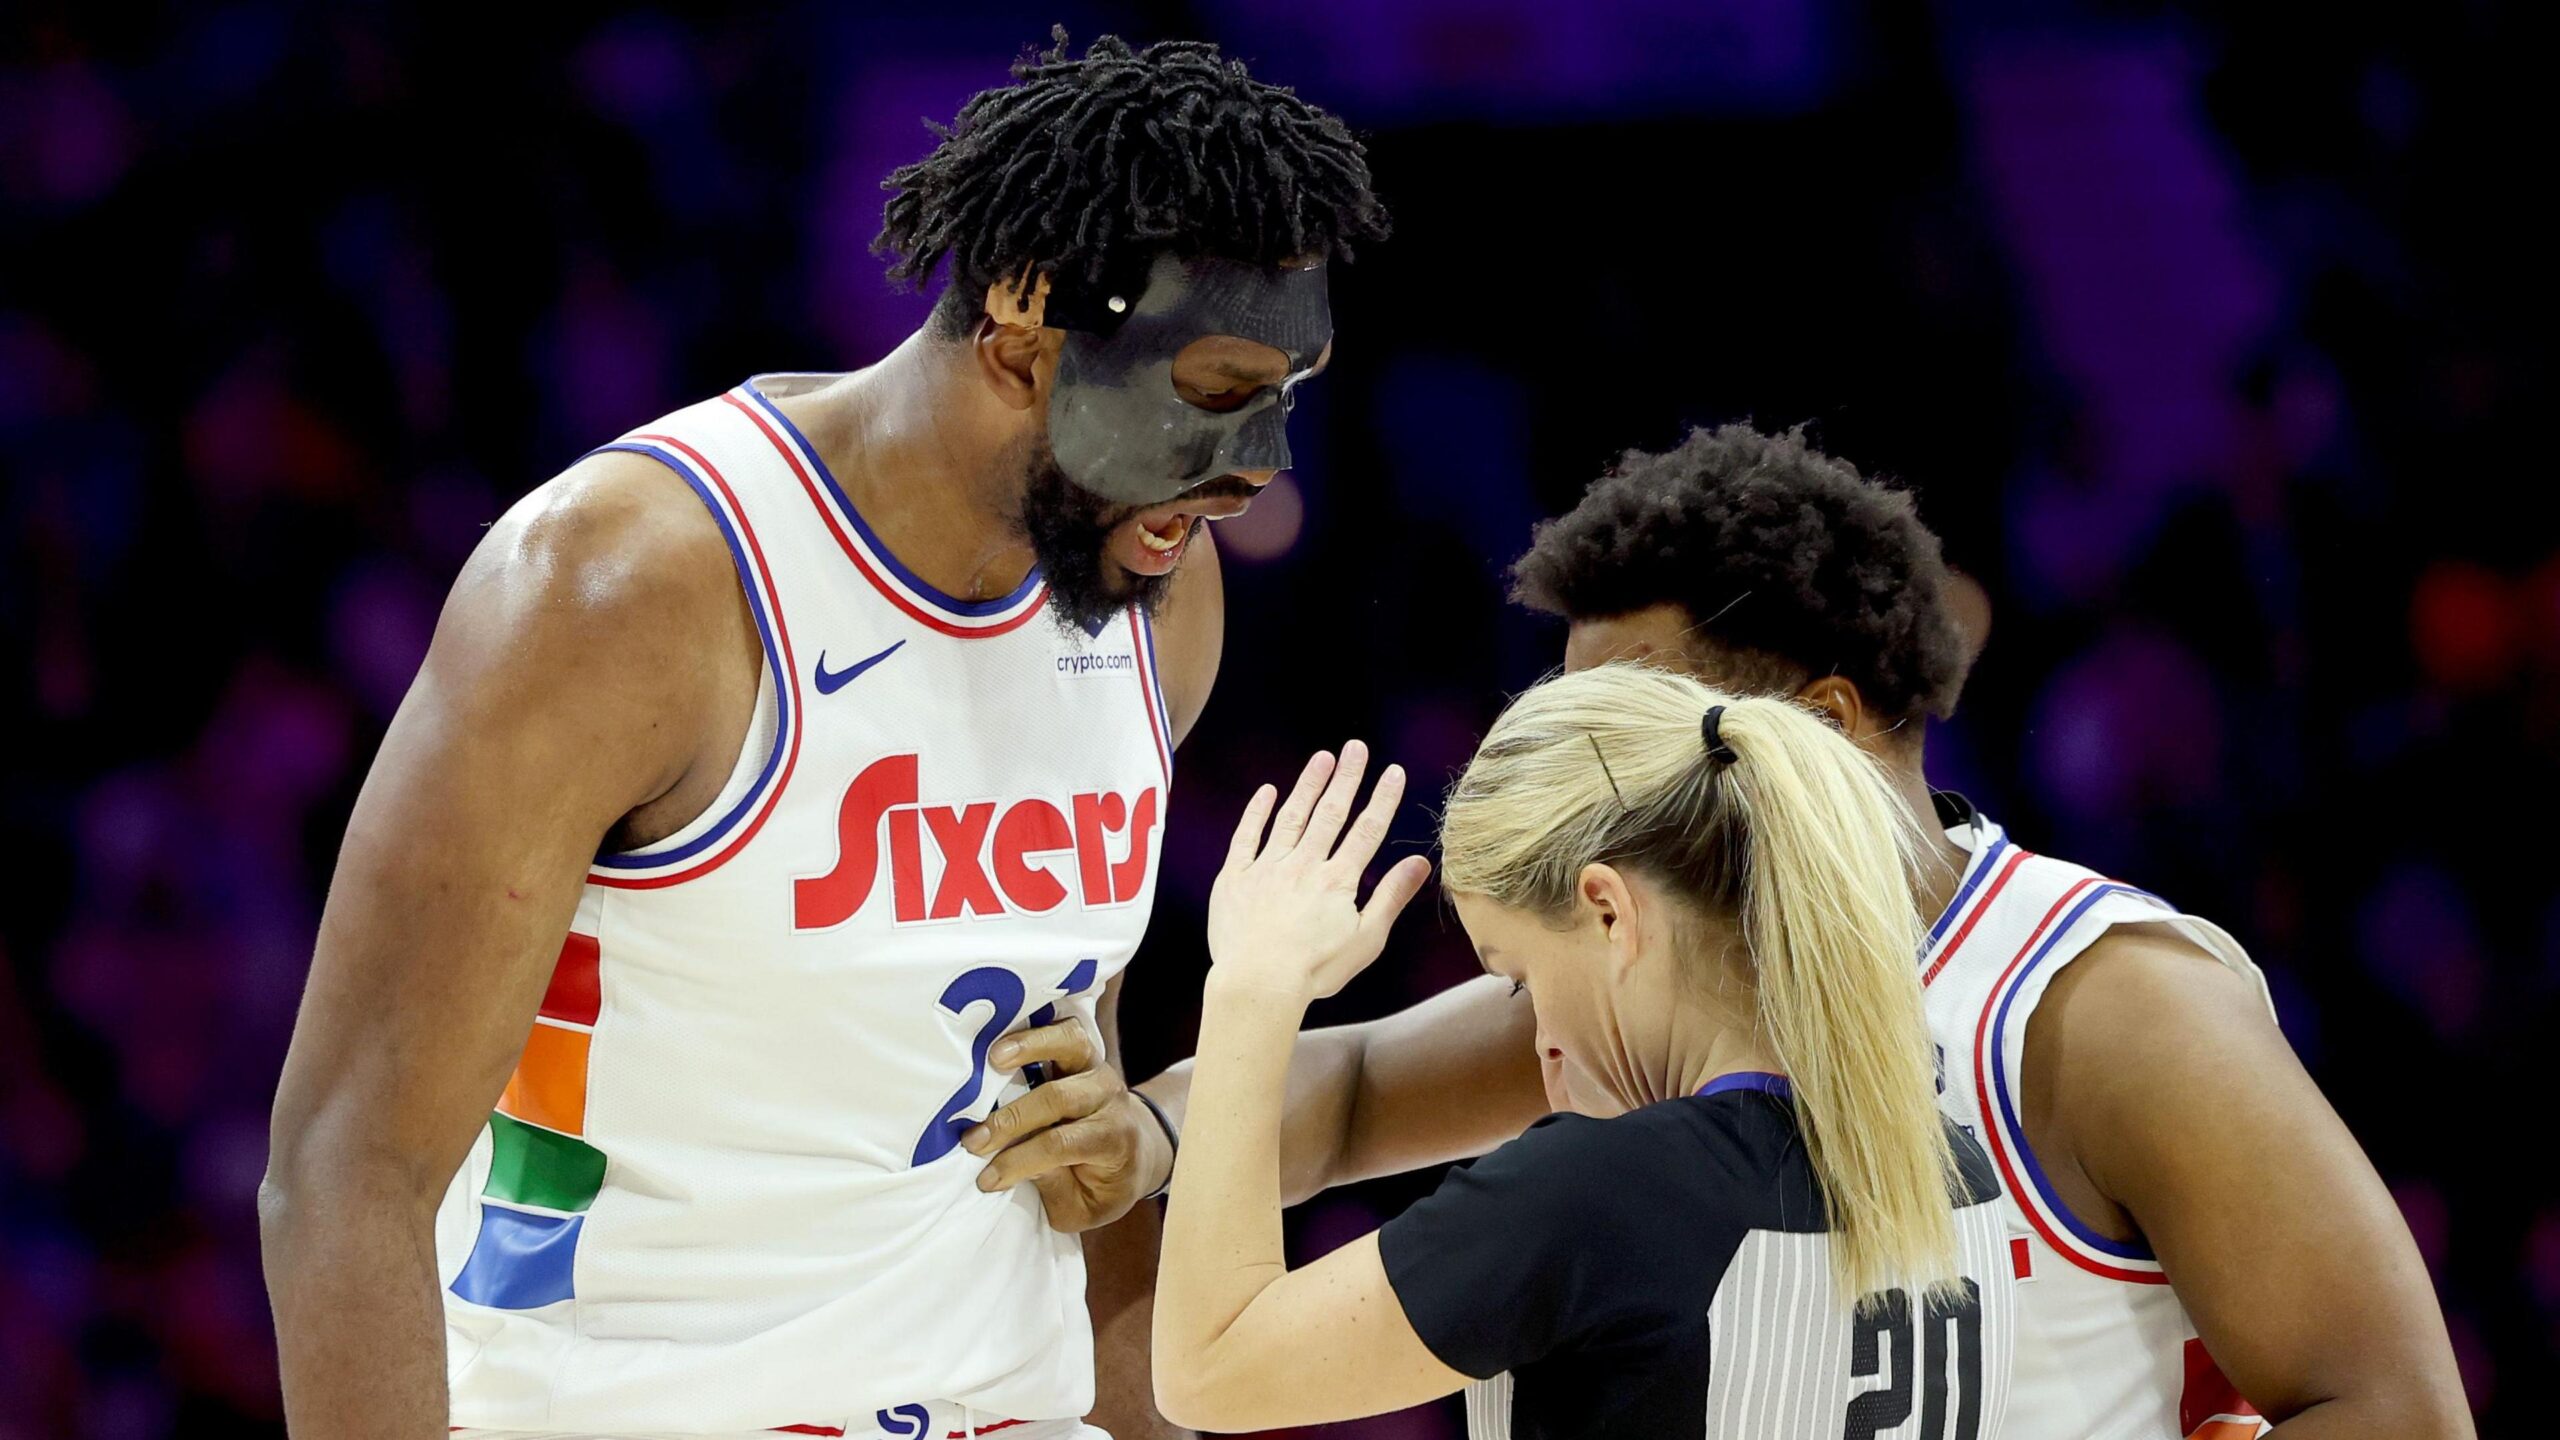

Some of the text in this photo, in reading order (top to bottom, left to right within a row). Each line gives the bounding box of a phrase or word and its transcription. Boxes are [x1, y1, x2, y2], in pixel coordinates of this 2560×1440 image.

[1057, 653, 1132, 674] crypto.com
[793, 752, 1157, 930] Sixers
[1843, 1276, 1982, 1440] 20
